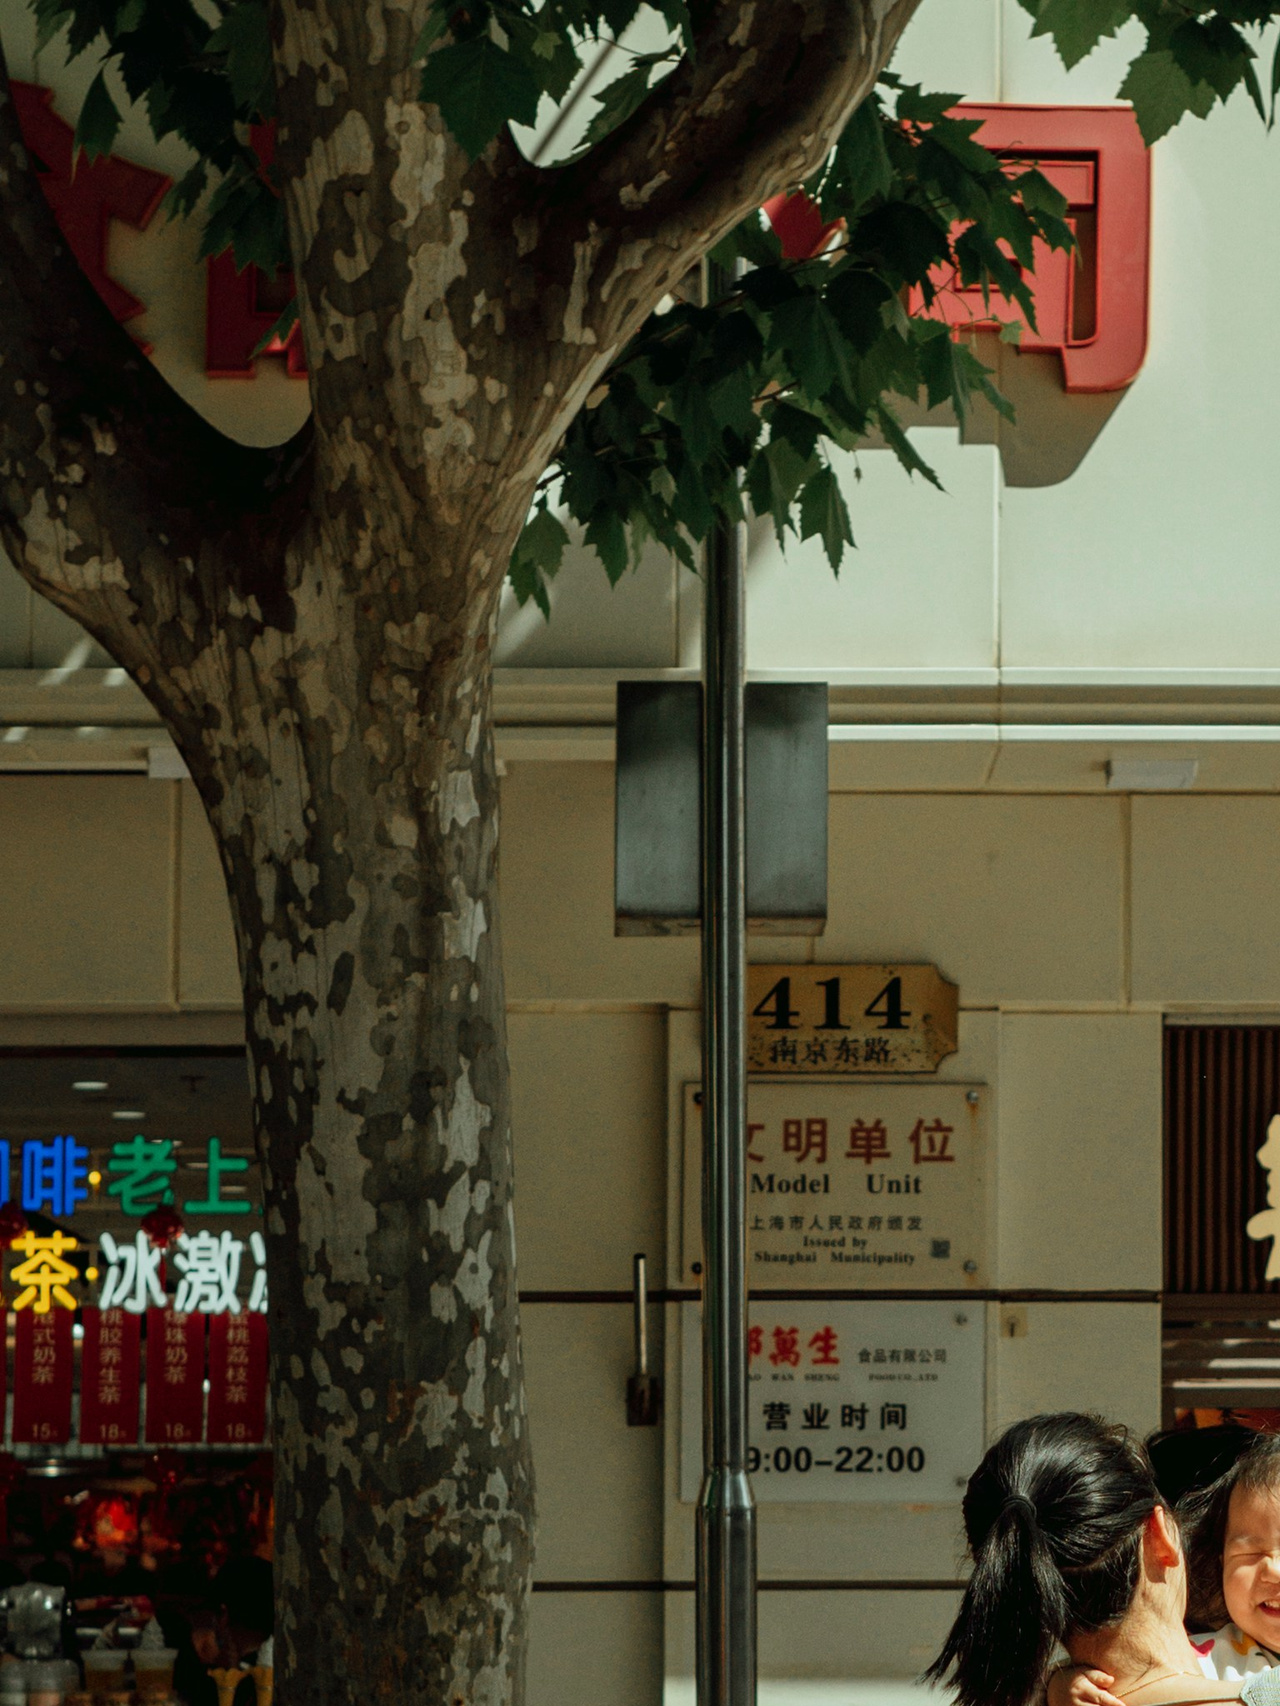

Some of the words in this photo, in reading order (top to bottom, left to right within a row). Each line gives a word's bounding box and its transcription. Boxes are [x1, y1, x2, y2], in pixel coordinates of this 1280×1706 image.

[753, 976, 911, 1030] 414
[769, 1036, 891, 1065] 南京东路
[0, 1134, 89, 1217] 啡
[107, 1134, 264, 1217] 老上
[750, 1174, 830, 1194] Model
[866, 1174, 922, 1194] Unit
[749, 1215, 923, 1231] 上海市人民政府颁发
[803, 1236, 846, 1248] Issued
[852, 1236, 868, 1250] by
[754, 1251, 817, 1266] Shanghai
[830, 1250, 916, 1266] Municipality
[0, 1230, 79, 1314] 茶
[857, 1347, 948, 1365] 食品有限公司
[804, 1373, 840, 1382] SHENG
[763, 1402, 908, 1431] 营业时间
